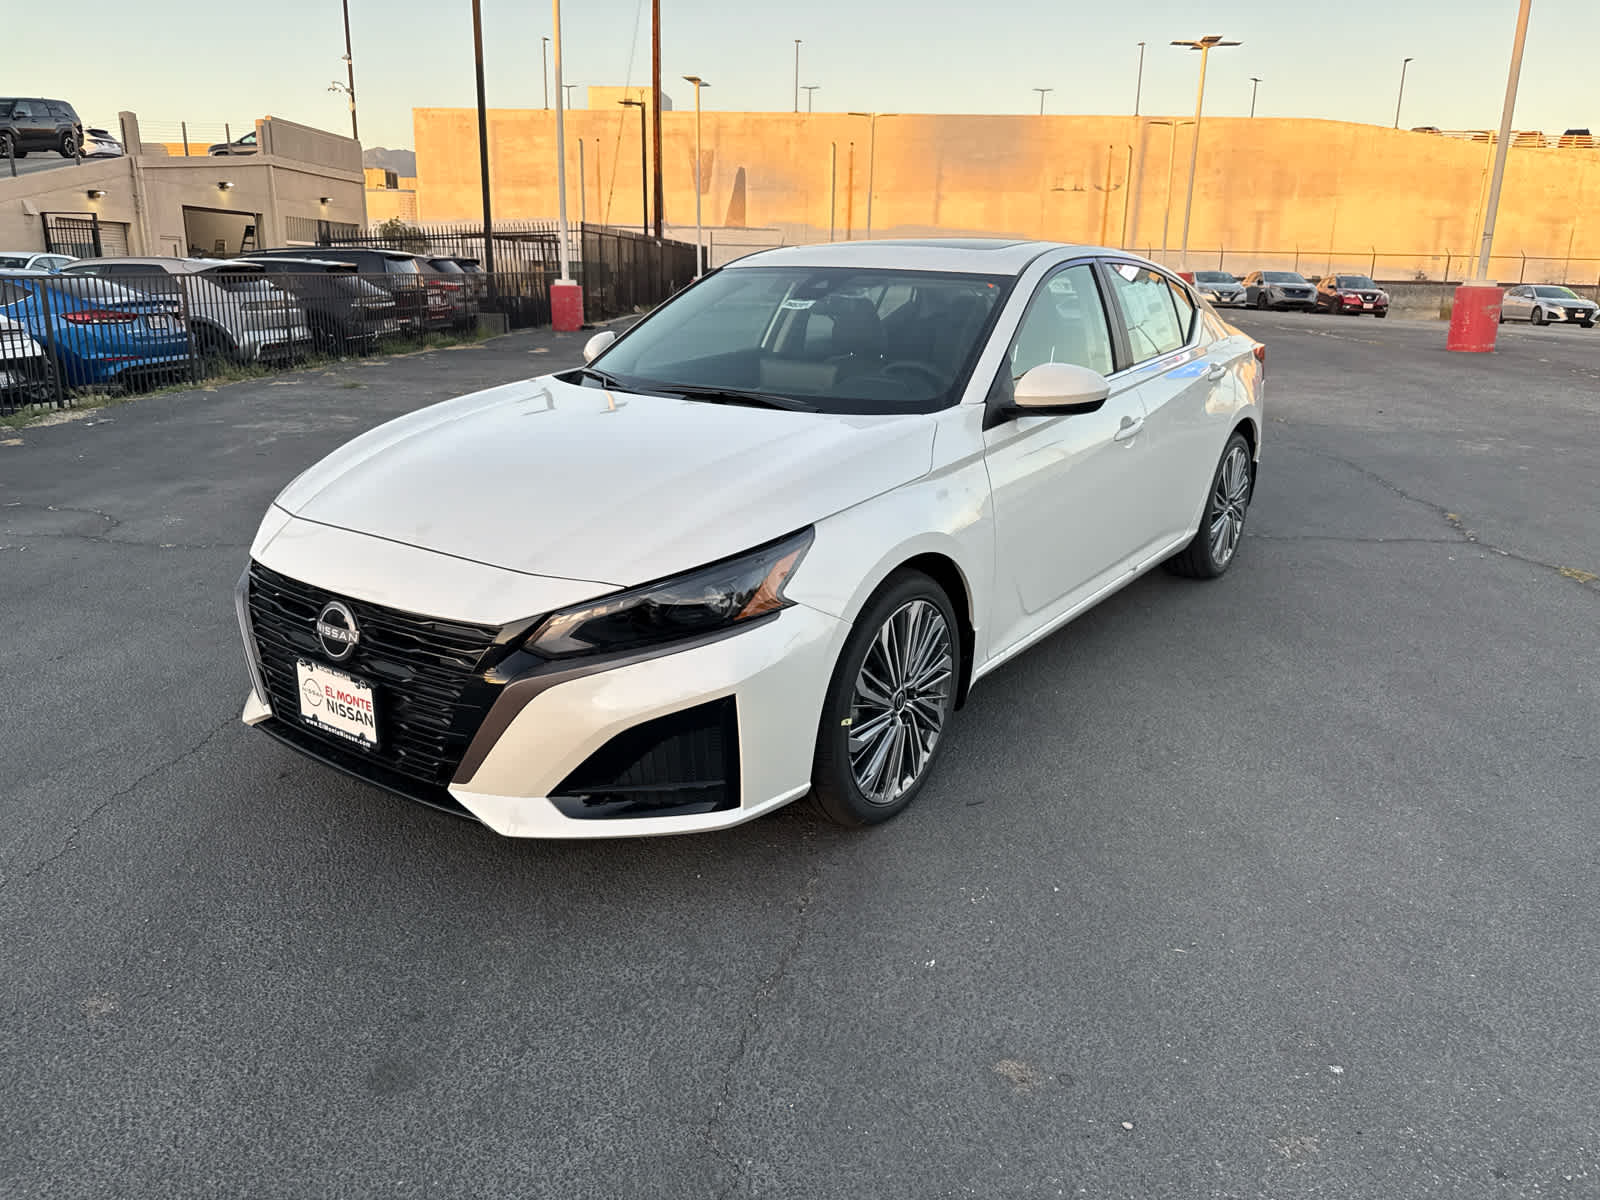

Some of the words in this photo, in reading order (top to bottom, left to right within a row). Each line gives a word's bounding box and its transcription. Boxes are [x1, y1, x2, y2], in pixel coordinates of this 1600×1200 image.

[316, 621, 358, 642] NISSAN
[325, 685, 336, 699] EL
[336, 690, 372, 712] MONTE
[326, 698, 374, 728] NISSAN
